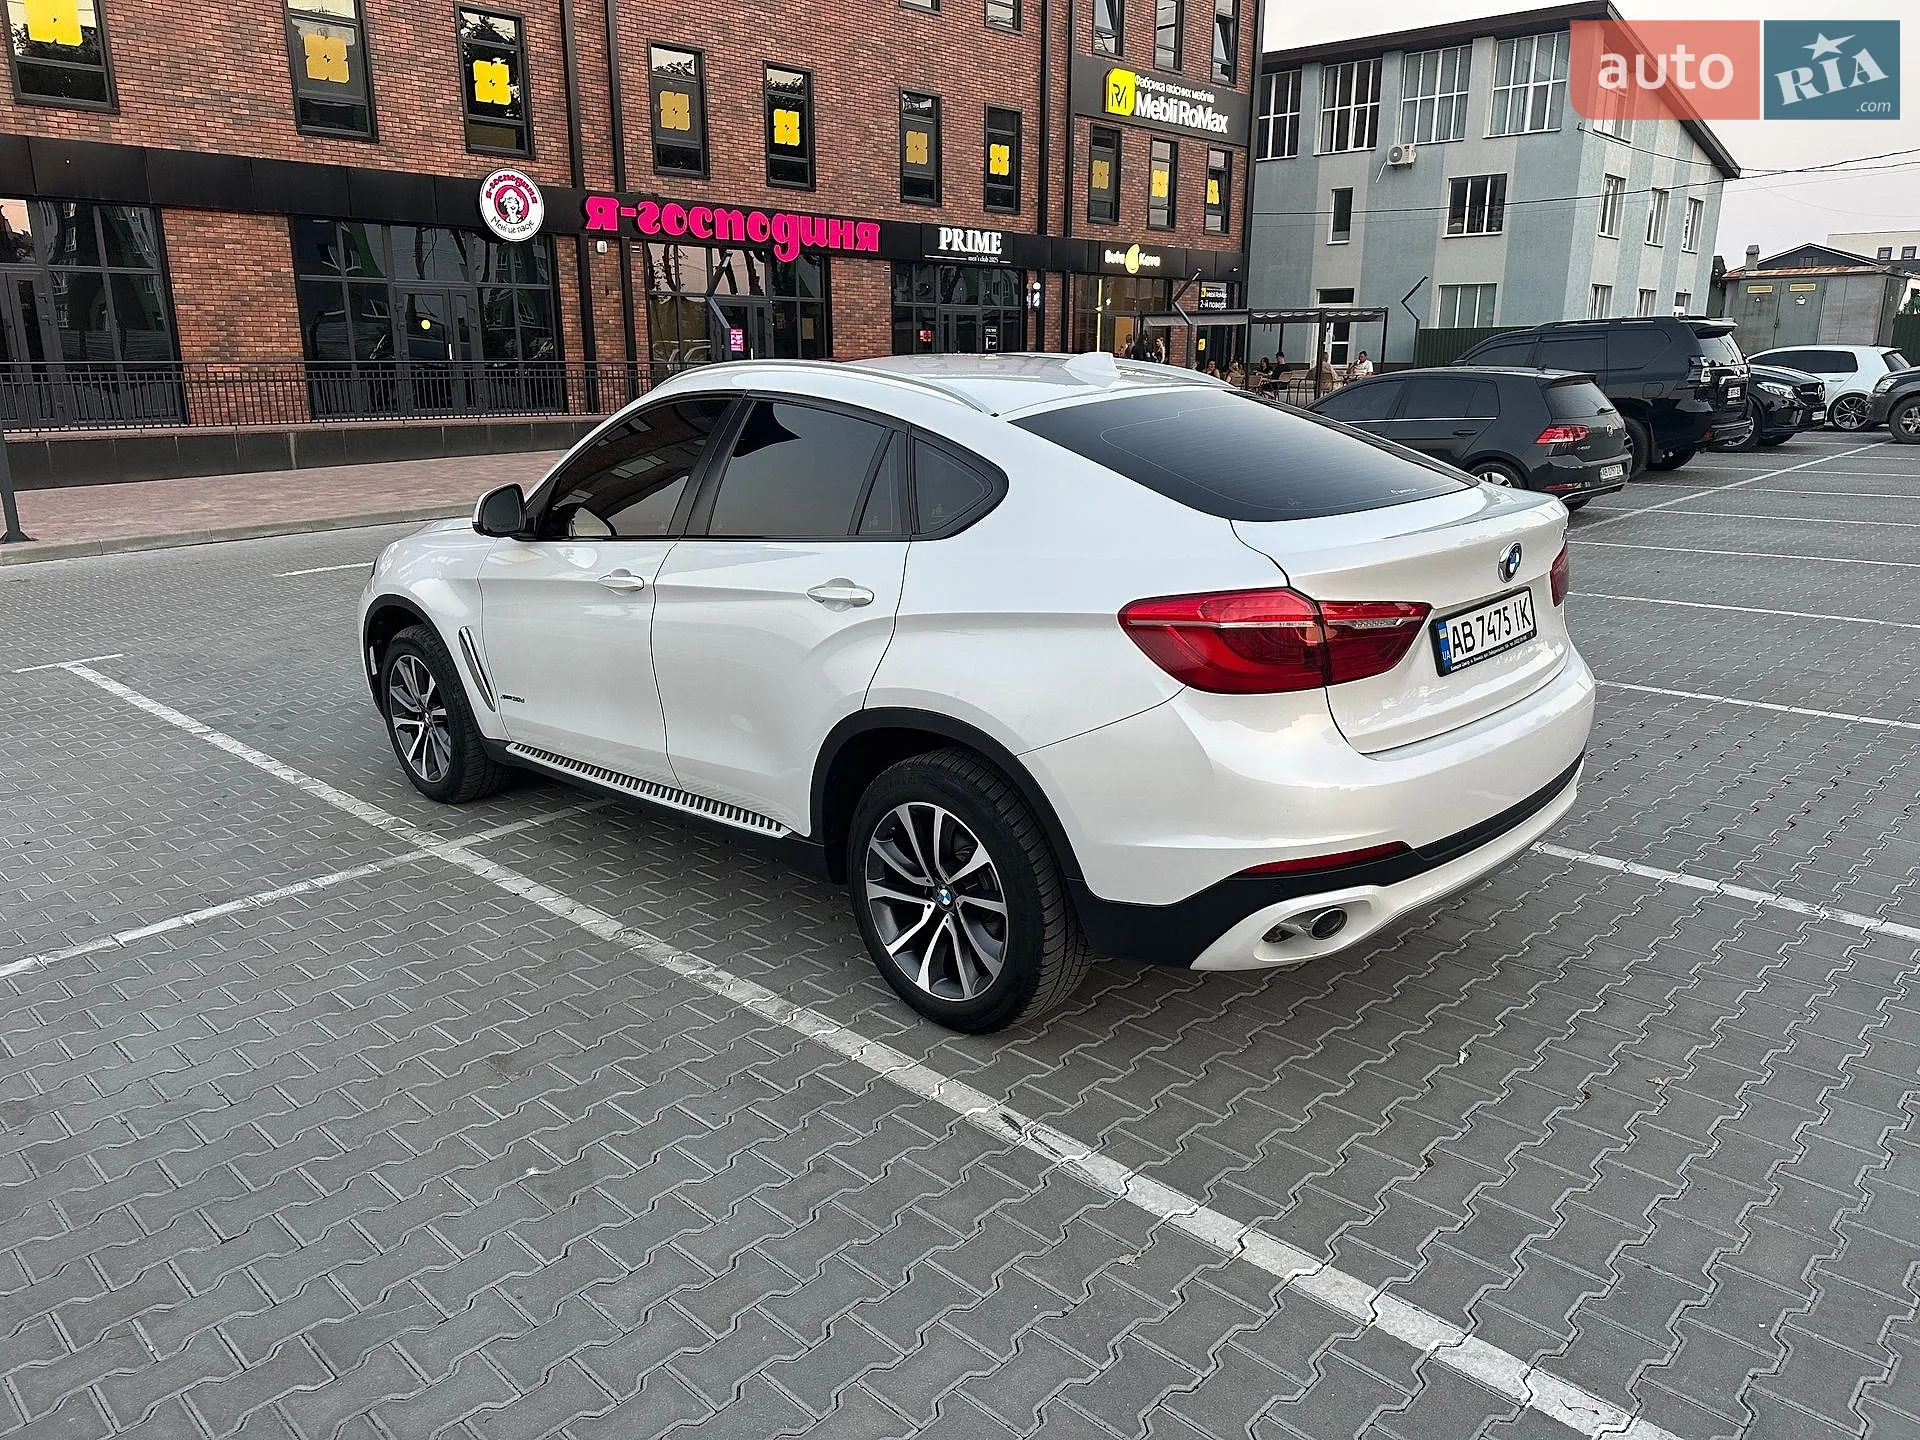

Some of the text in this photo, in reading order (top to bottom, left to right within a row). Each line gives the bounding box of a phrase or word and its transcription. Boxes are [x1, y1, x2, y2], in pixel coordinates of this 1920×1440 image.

[1135, 75, 1165, 93] Фабрика
[938, 227, 1002, 254] PRIME
[1452, 621, 1475, 658] AB
[1476, 606, 1511, 647] 7475
[1514, 597, 1531, 631] IK
[1442, 650, 1451, 660] UA
